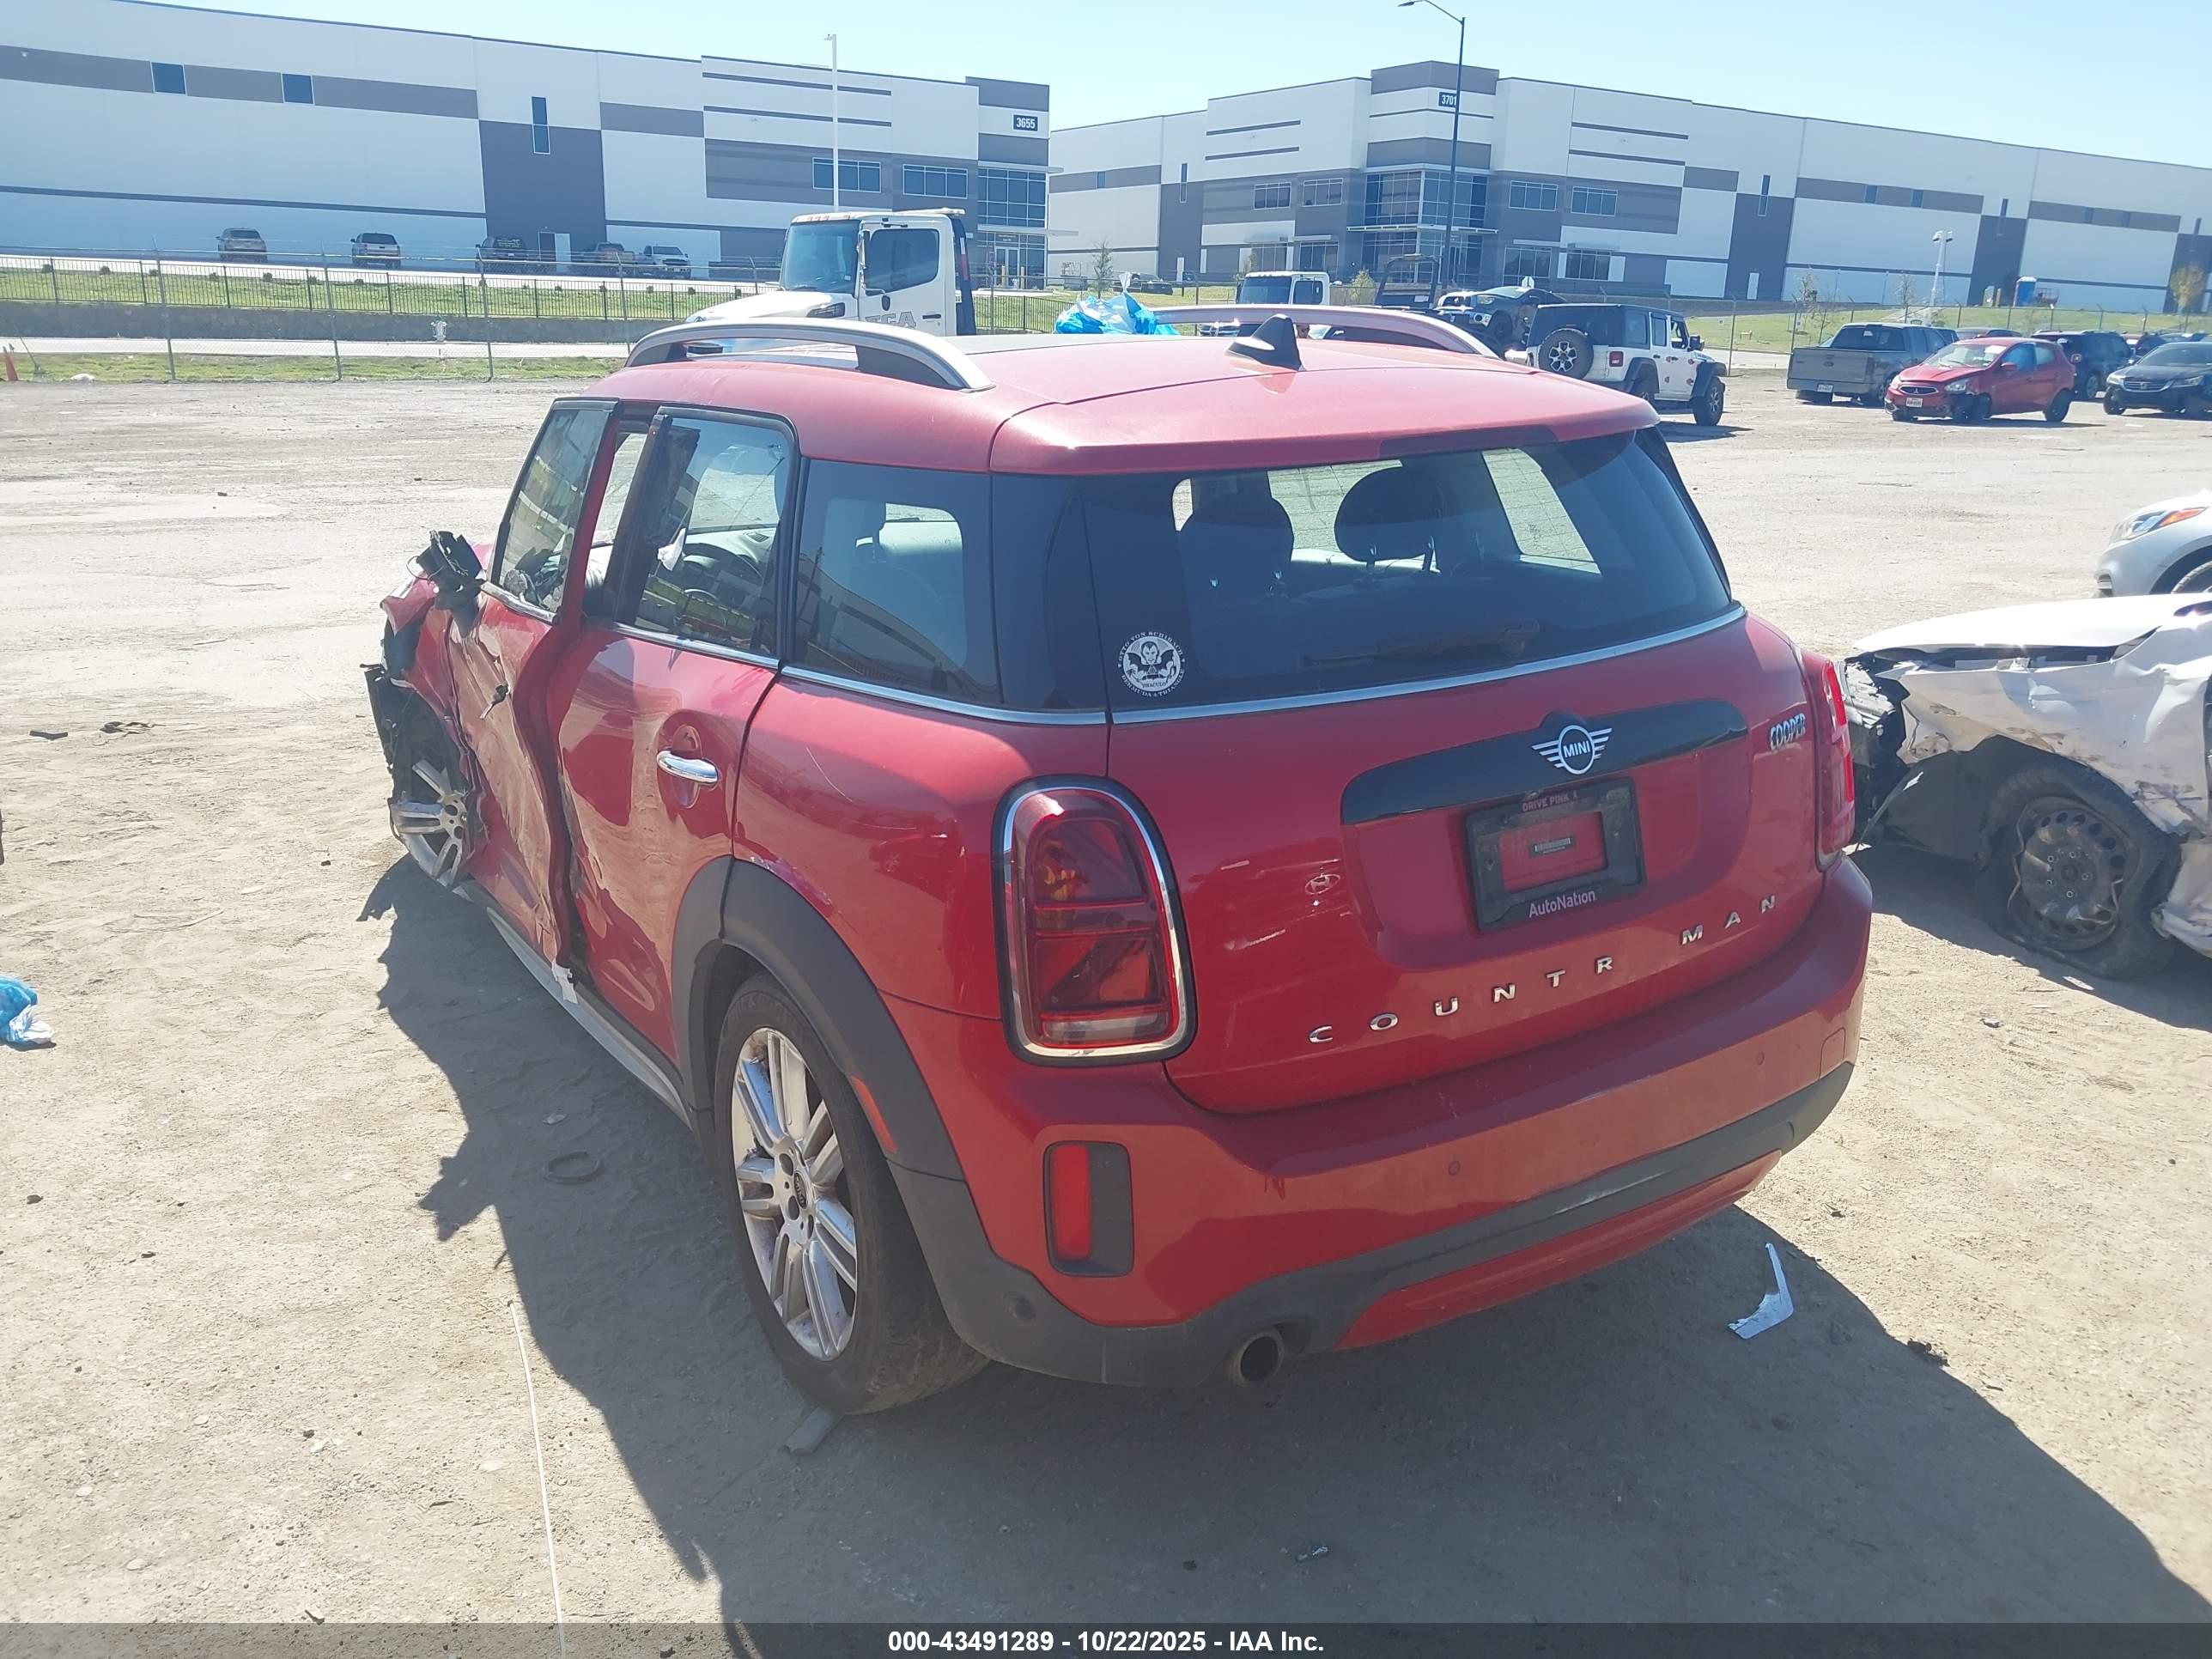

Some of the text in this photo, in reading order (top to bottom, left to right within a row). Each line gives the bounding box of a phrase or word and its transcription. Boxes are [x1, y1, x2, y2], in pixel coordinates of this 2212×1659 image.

[1442, 94, 1457, 106] 3701
[1016, 117, 1036, 129] 3655
[1770, 713, 1806, 750] COOPER
[1563, 740, 1590, 757] MINI
[1522, 793, 1570, 812] DRIVE PINK
[1528, 890, 1596, 918] AutoNation
